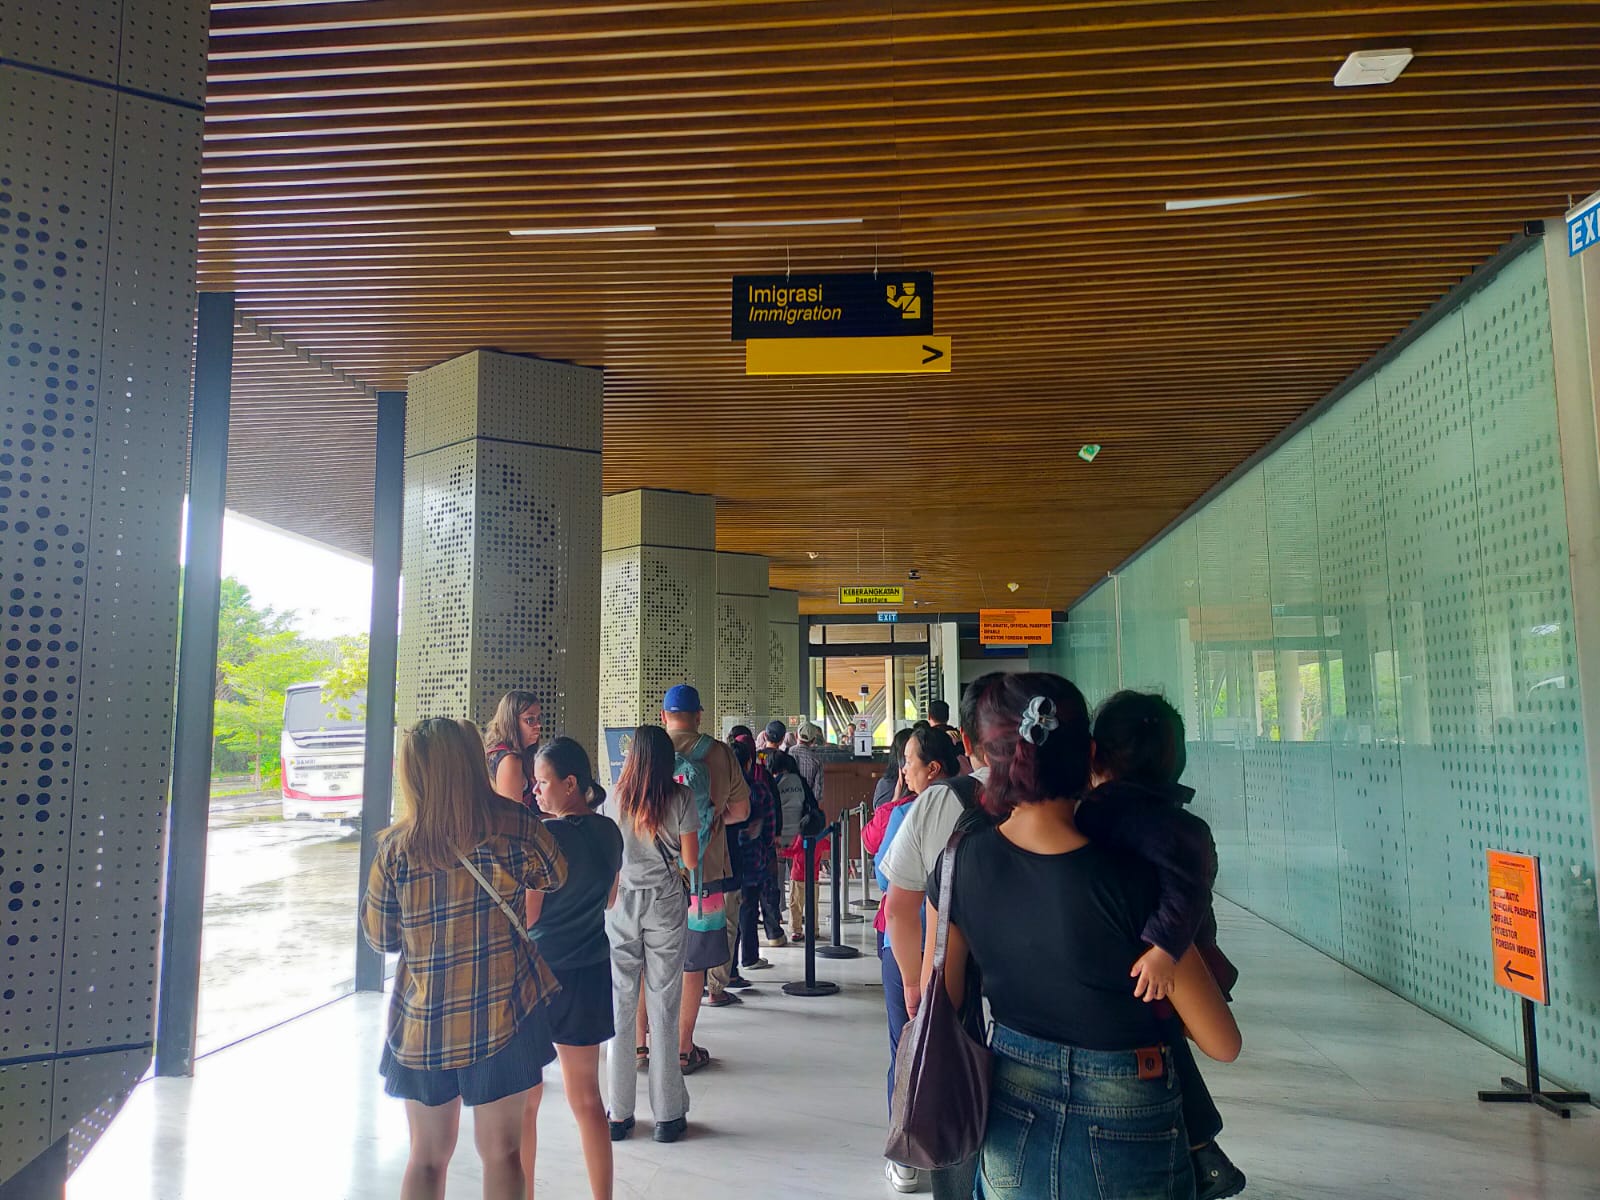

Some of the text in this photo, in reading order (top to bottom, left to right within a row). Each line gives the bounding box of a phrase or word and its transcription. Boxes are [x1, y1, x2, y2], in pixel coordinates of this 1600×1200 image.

[749, 284, 822, 306] Imigrasi
[749, 305, 842, 325] Immigration
[843, 588, 900, 596] KEBERANGKATAN
[861, 740, 866, 752] 1
[1493, 901, 1537, 919] OFFICIAL PASSPORT
[1493, 913, 1512, 926] DIFABLE
[1495, 926, 1518, 940] INVESTOR
[1495, 938, 1536, 958] FOREIGN WORKER
